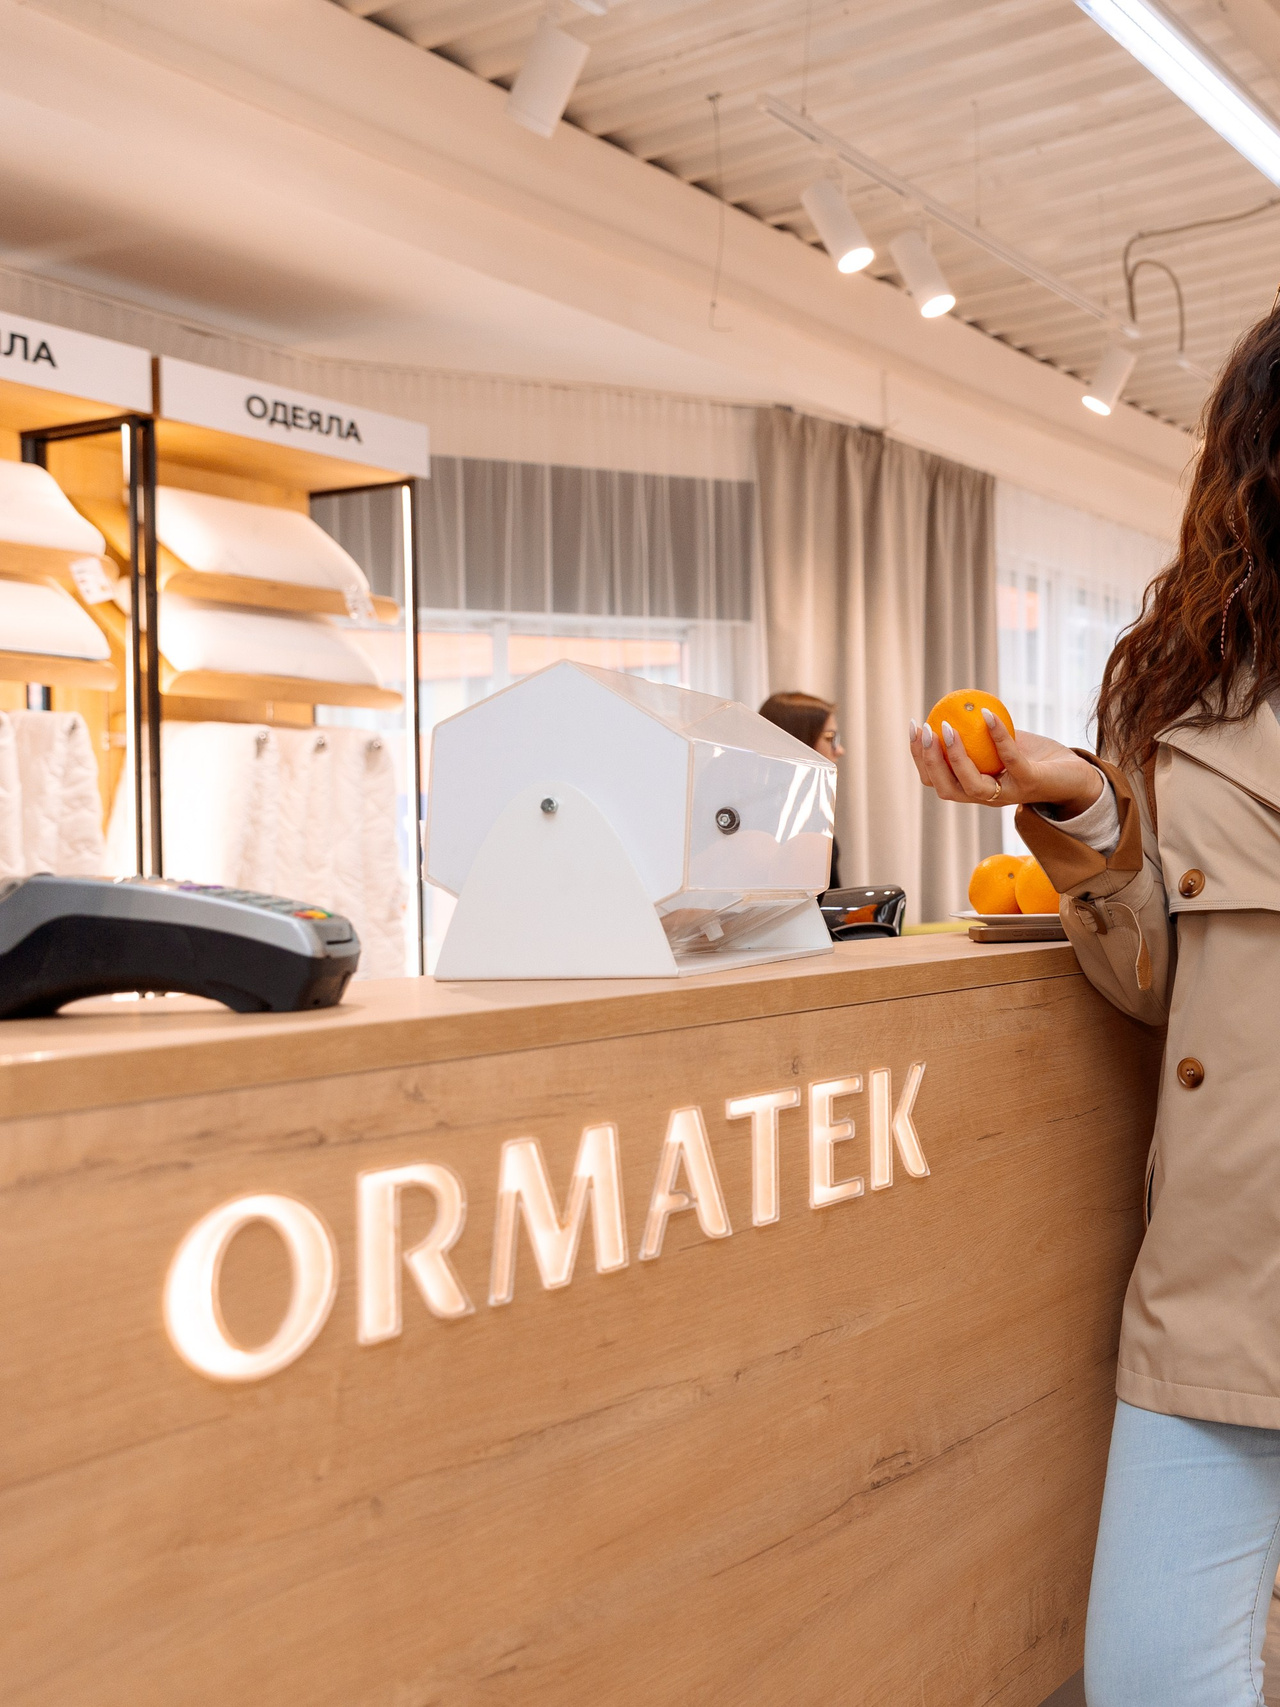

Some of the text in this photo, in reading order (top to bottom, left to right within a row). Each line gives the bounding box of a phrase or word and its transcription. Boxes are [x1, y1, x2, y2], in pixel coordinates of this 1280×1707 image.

[0, 331, 56, 368] ЛА
[245, 394, 362, 443] ОДЕЯЛА
[163, 1062, 931, 1382] ORMATEK
